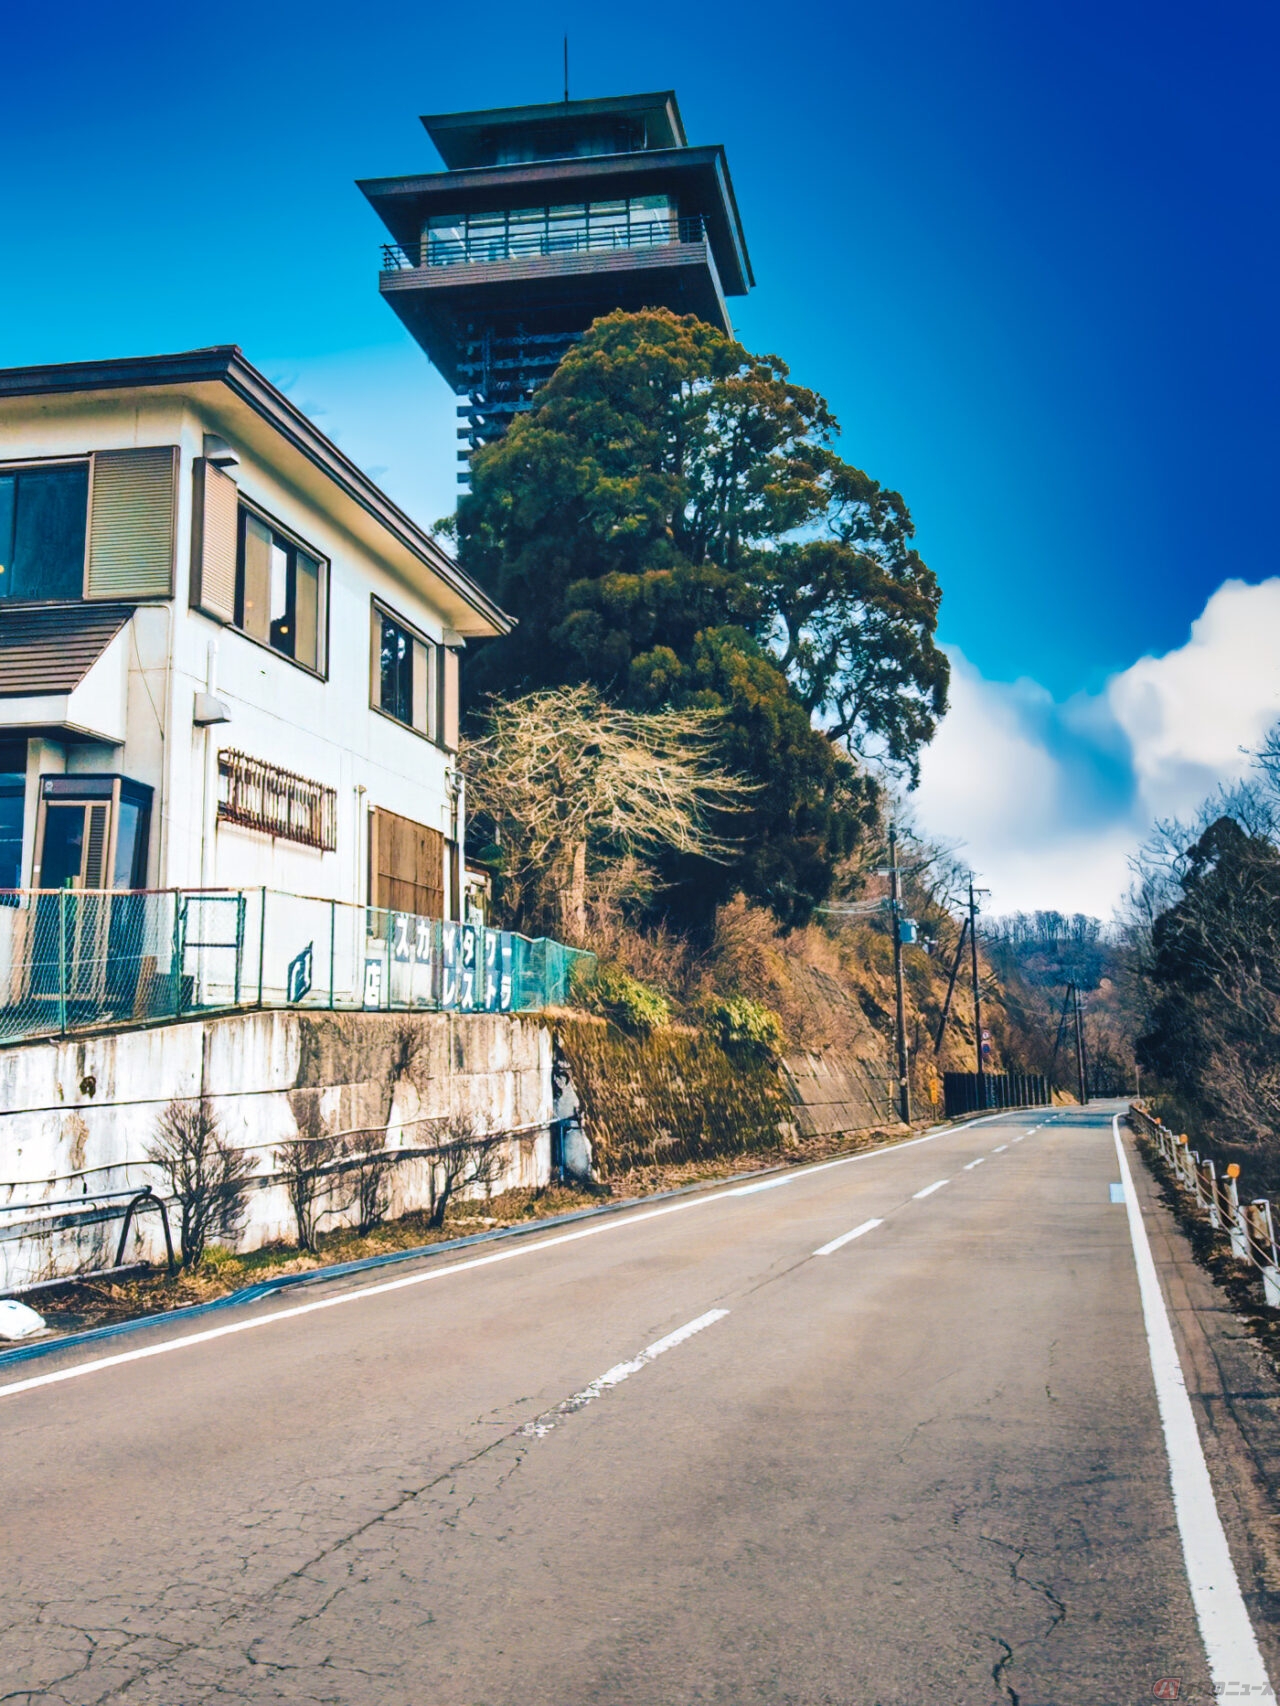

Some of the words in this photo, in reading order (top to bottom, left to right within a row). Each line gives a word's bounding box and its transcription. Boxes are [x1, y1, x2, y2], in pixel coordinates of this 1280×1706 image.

[396, 915, 512, 968] スカイタワー
[365, 962, 381, 1006] 店
